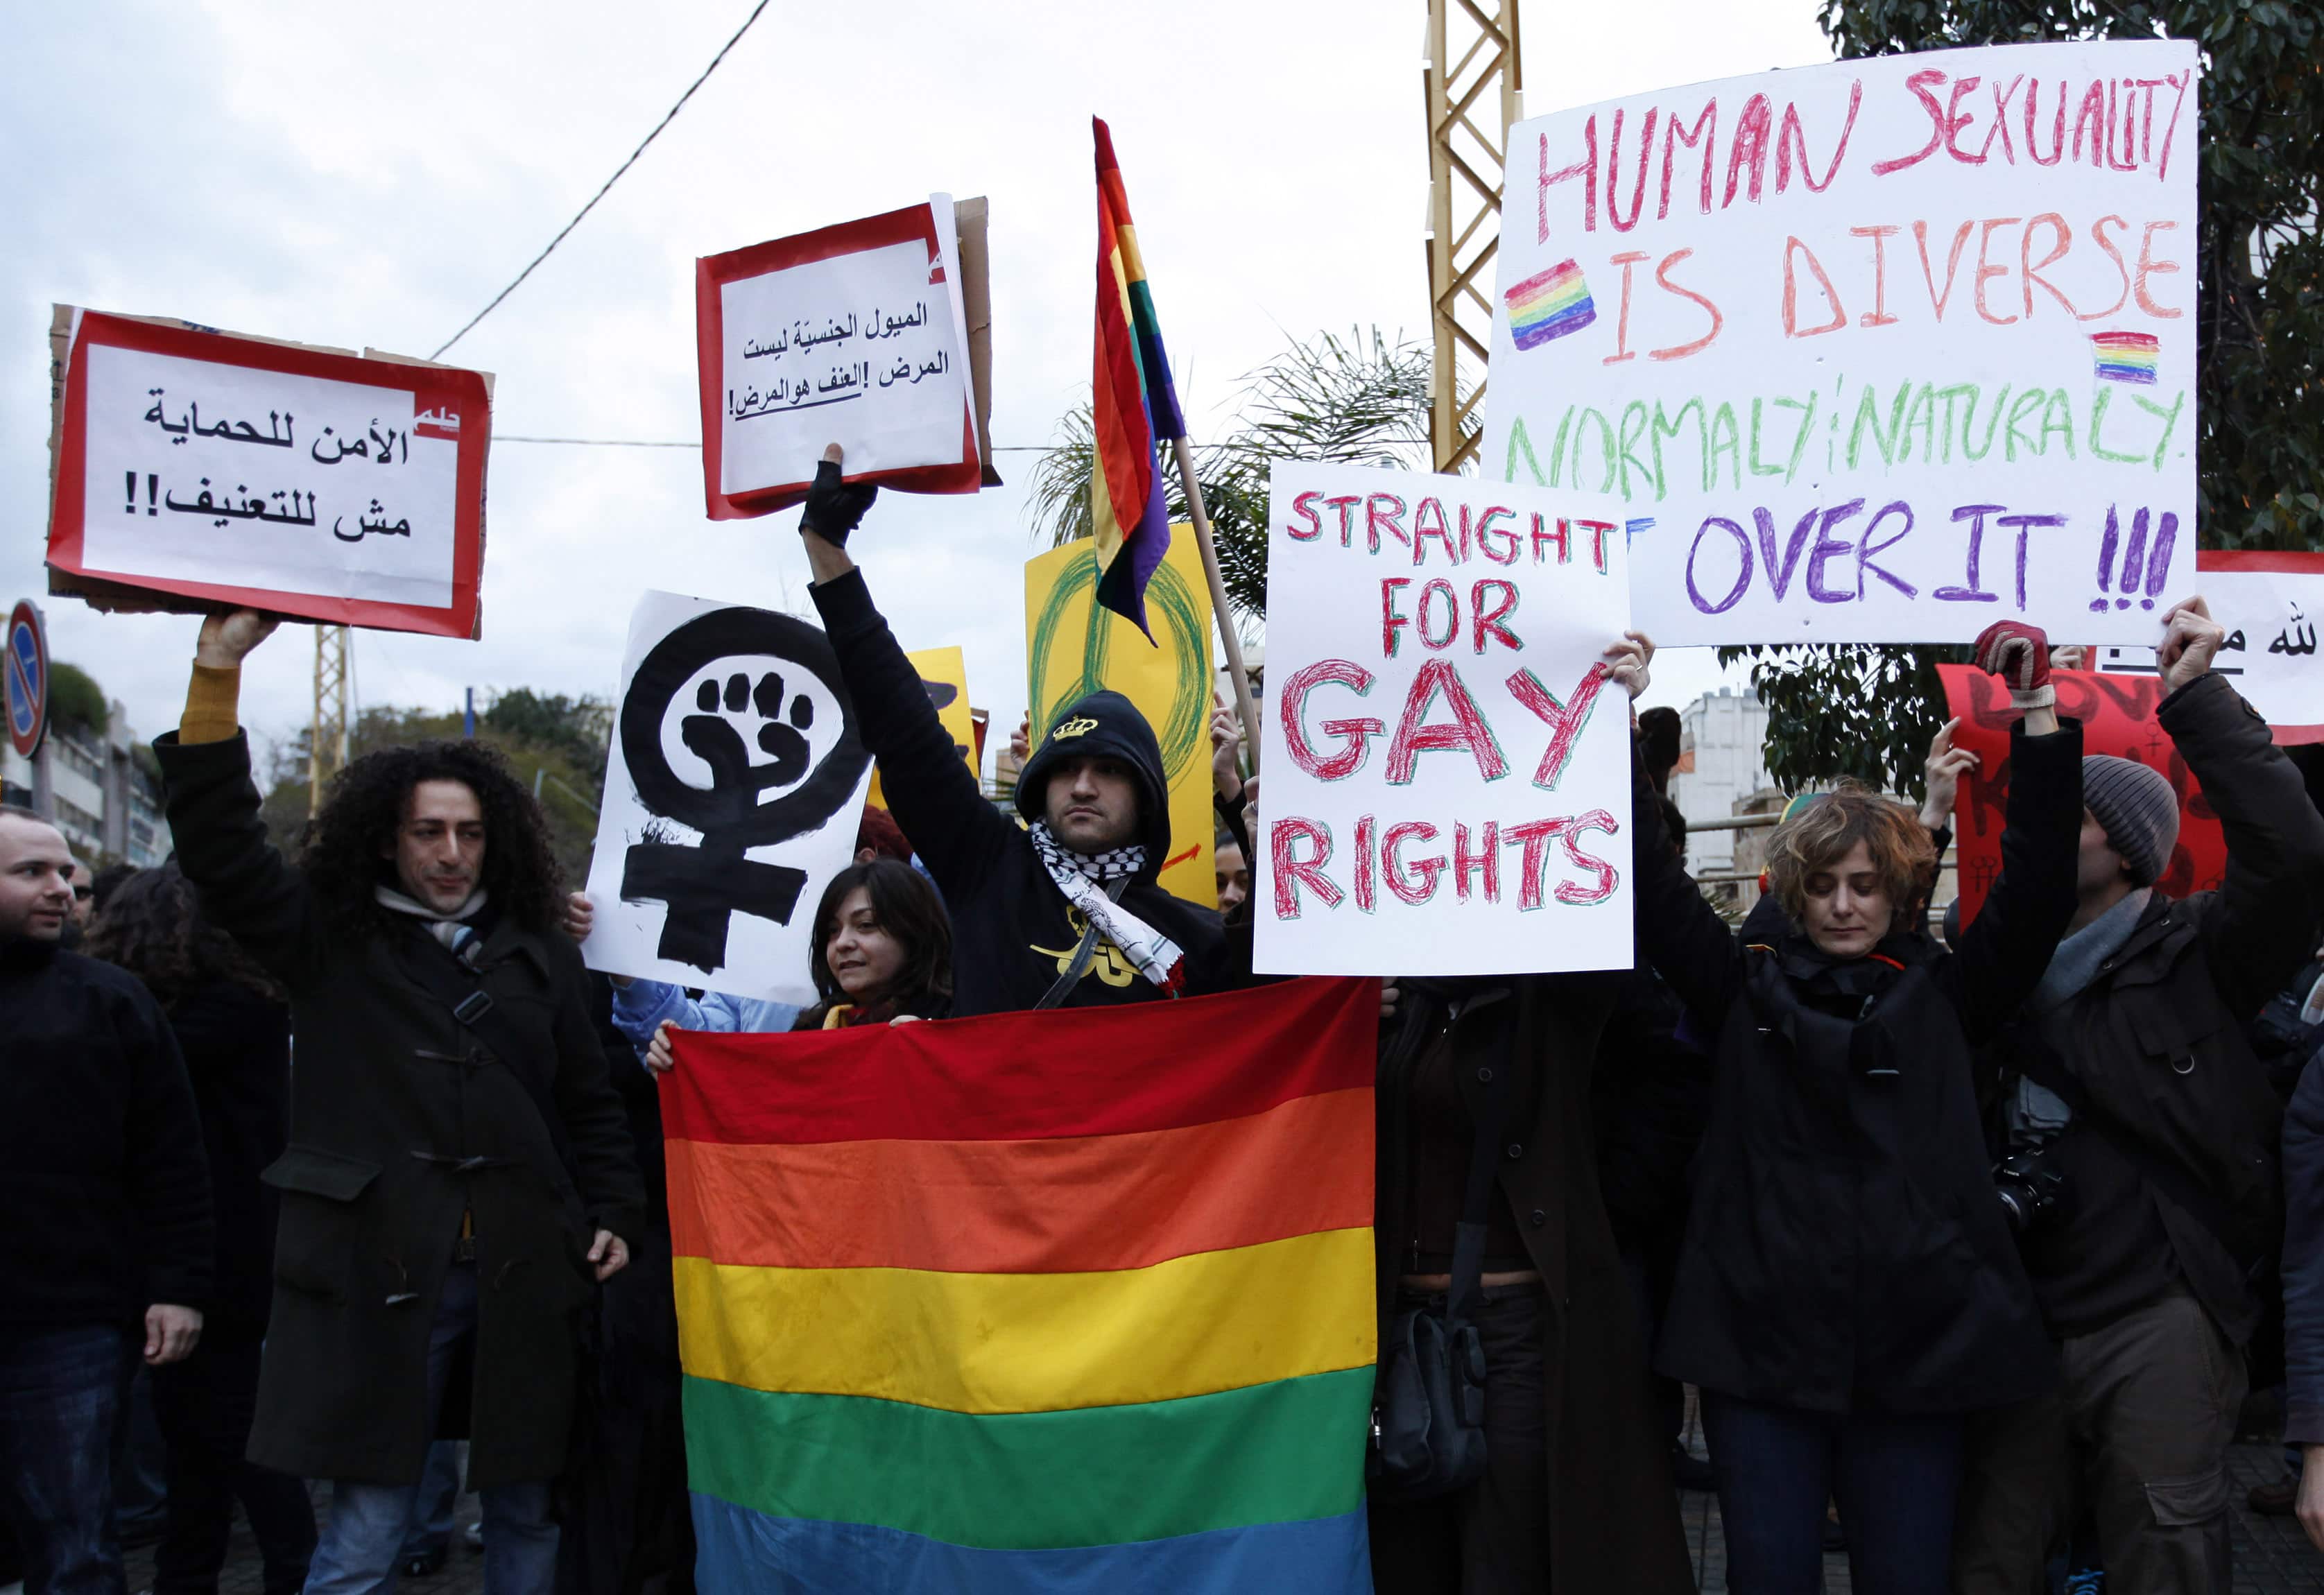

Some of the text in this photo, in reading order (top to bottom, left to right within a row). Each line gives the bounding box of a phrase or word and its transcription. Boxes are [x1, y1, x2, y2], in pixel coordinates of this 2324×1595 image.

[1538, 78, 1863, 245] HUMAN
[866, 301, 928, 340] الميول
[1602, 212, 2185, 366] IS DIVERSE
[743, 328, 788, 361] ليست
[144, 387, 409, 465] الأمن للحماية
[414, 406, 461, 431] حلم
[333, 497, 411, 542] مش
[1286, 490, 1619, 576] STRAIGHT
[1685, 497, 1918, 614] OVER
[1933, 503, 2070, 612] IT
[1379, 576, 1524, 661] FOR
[1279, 656, 1609, 793] GAY
[1967, 671, 2165, 731] LOV
[1269, 807, 1621, 922] RIGHTS
